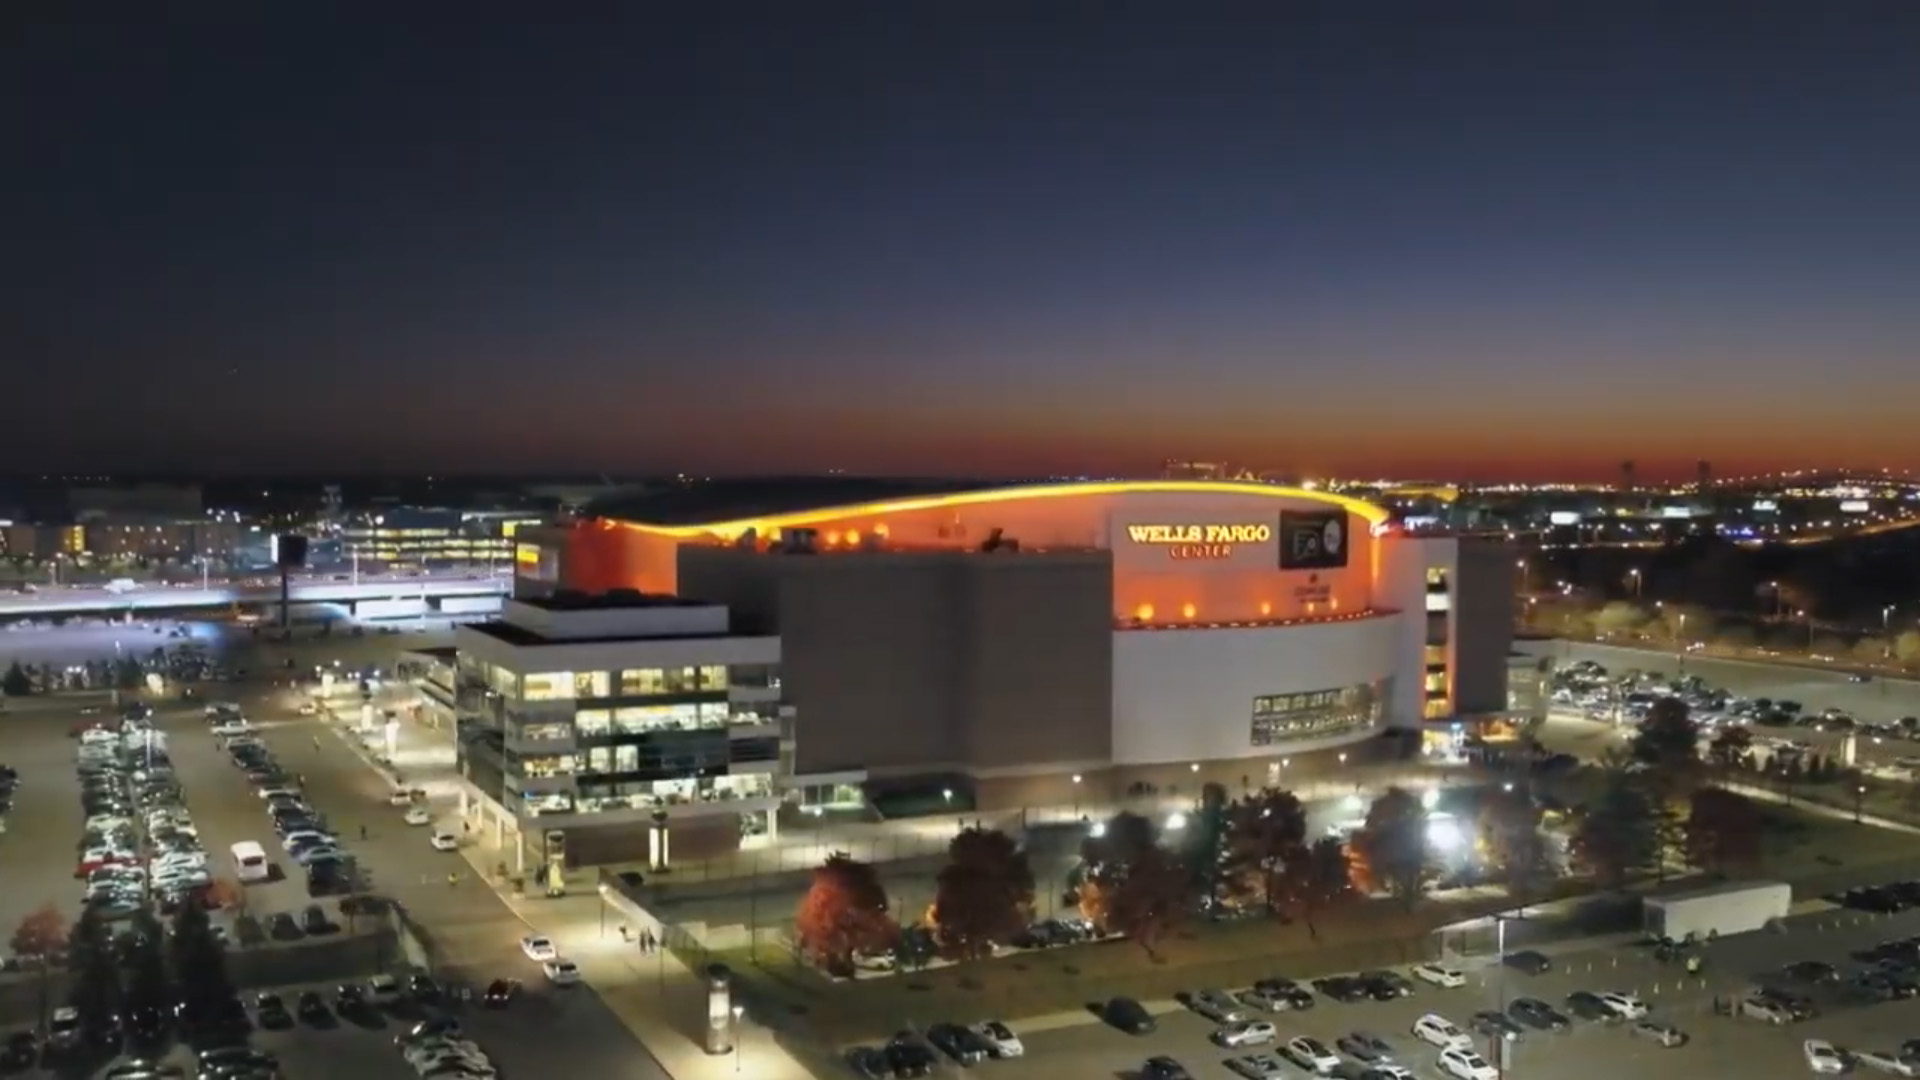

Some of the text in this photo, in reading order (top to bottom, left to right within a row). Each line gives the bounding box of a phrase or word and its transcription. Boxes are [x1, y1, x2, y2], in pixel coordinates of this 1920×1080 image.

[1128, 524, 1270, 542] WELLS FARGO
[1170, 545, 1231, 557] CENTER
